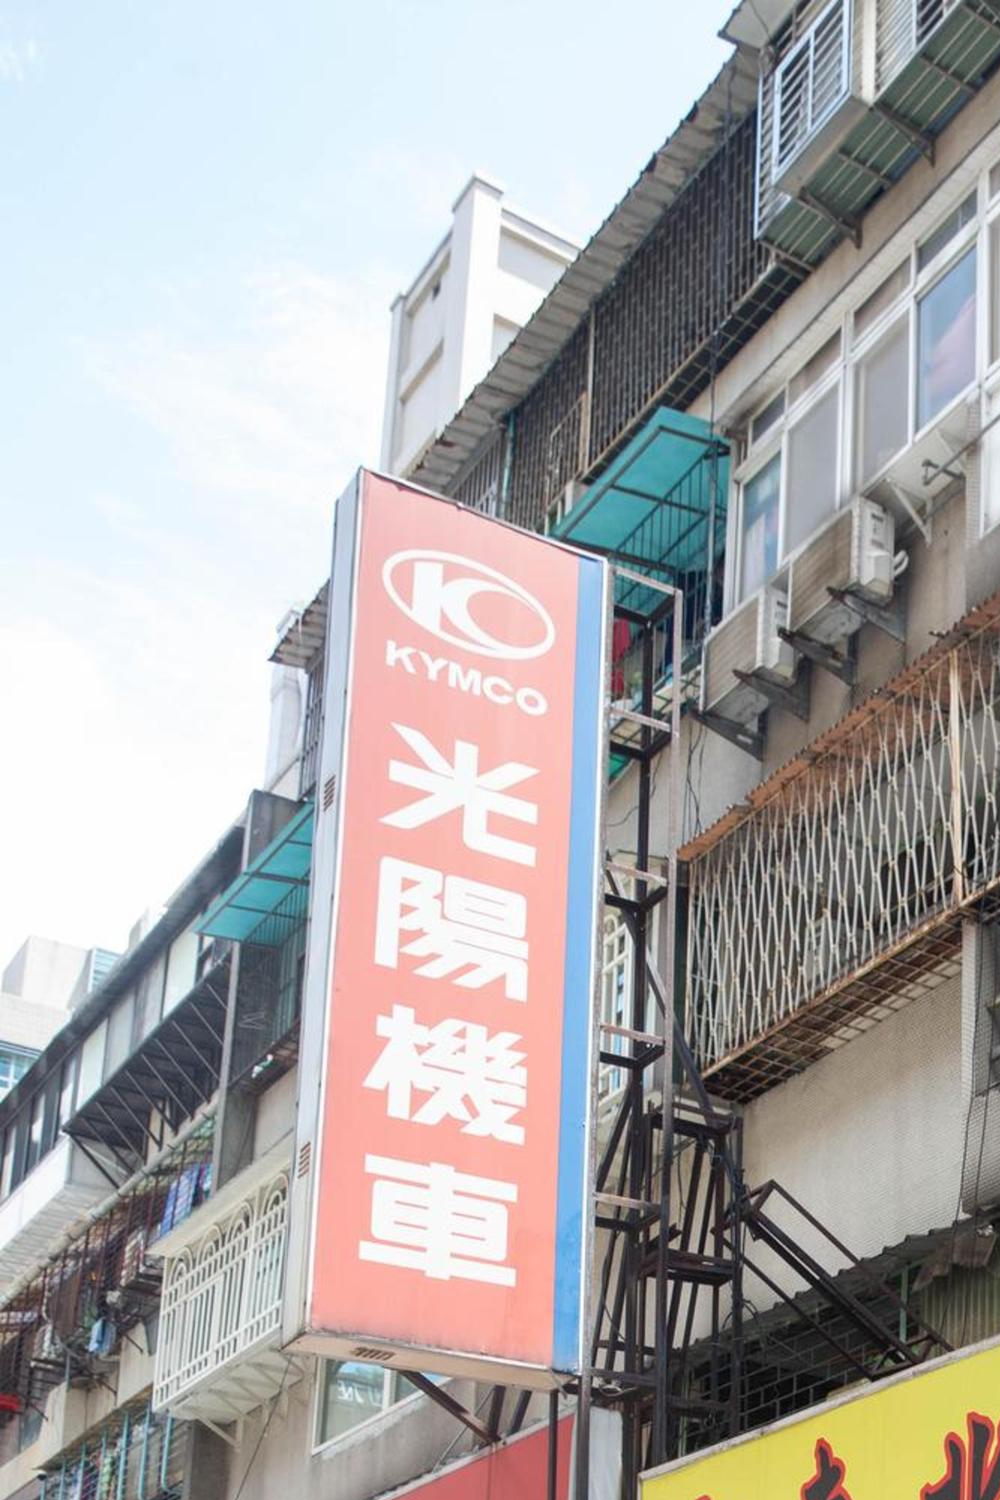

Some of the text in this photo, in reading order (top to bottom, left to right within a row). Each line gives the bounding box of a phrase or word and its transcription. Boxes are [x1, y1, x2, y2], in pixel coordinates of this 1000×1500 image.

[384, 645, 549, 717] KYMCO
[356, 721, 542, 1288] 光陽機車
